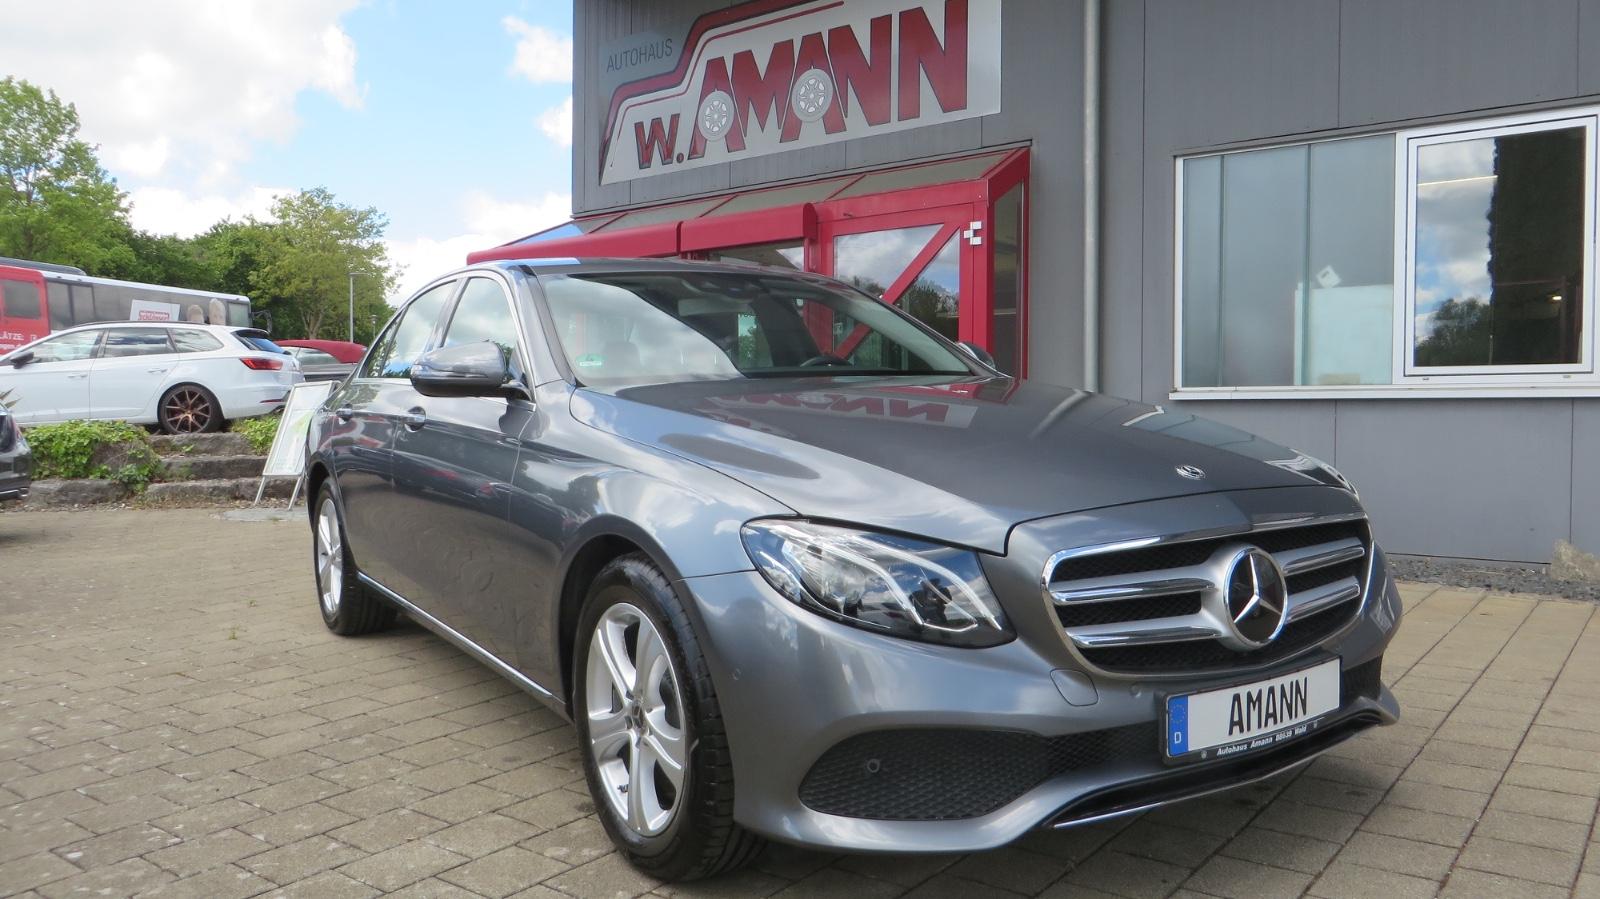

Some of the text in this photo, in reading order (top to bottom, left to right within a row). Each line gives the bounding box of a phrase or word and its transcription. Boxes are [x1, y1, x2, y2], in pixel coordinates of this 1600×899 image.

[607, 39, 673, 72] AUTOHAUS
[1229, 678, 1308, 736] AMANN
[1174, 731, 1182, 744] D
[1217, 743, 1248, 756] Autohaus
[1250, 737, 1273, 748] Amann
